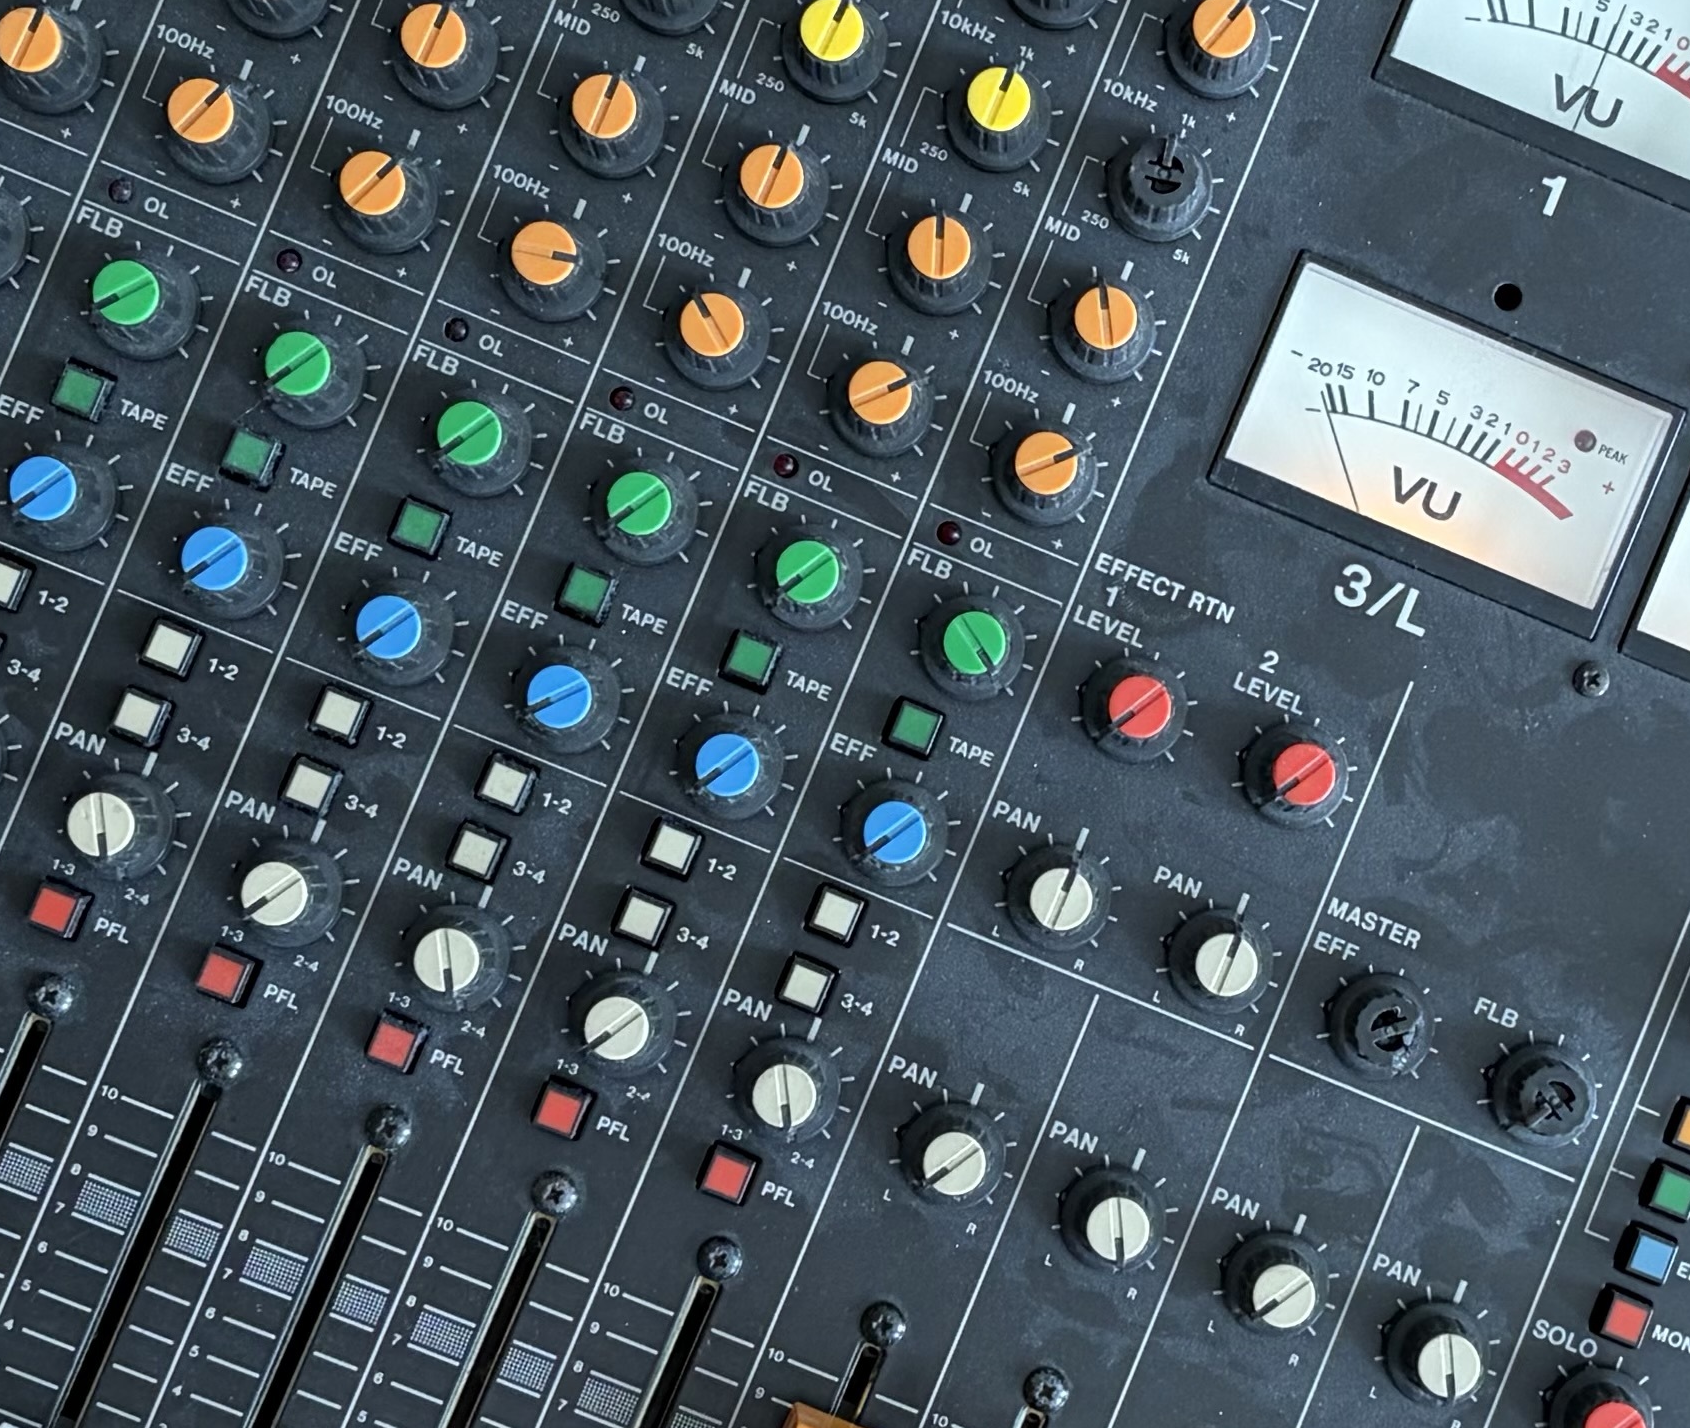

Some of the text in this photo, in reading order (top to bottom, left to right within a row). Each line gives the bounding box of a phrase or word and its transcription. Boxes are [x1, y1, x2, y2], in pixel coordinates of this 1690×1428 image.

[157, 23, 215, 60] 100Hz
[941, 9, 997, 45] 10kHz
[325, 94, 384, 130] 100Hz
[1103, 78, 1158, 113] 10kHz
[1554, 73, 1624, 129] VU
[881, 147, 919, 174] MID
[493, 163, 550, 199] 100Hz
[1541, 175, 1567, 217] 1
[76, 205, 124, 239] FLB
[143, 196, 169, 220] OL
[658, 232, 715, 268] 100Hz
[244, 274, 293, 308] FLB
[822, 300, 878, 336] 100Hz
[412, 343, 460, 376] FLB
[984, 369, 1039, 404] 100Hz
[579, 412, 626, 445] FLB
[643, 401, 669, 425] OL
[1597, 443, 1628, 466] PEAK
[165, 461, 215, 493] EFF
[1393, 465, 1463, 522] VU
[743, 479, 790, 512] FLB
[333, 531, 383, 561] EFF
[456, 535, 503, 568] TAPE
[906, 547, 953, 580] FLB
[1094, 551, 1236, 624] EFFECT RTN
[1105, 585, 1120, 608] 1
[1333, 563, 1426, 638] 3/L
[499, 599, 549, 630] EFF
[1072, 604, 1143, 649] LEVEL
[1258, 649, 1280, 675] 2
[665, 666, 714, 696] EFF
[1233, 671, 1304, 716] LEVEL
[54, 721, 107, 756] PAN
[176, 726, 211, 752] 3-4
[829, 732, 878, 762] EFF
[949, 735, 995, 768] TAPE
[224, 789, 277, 824] PAN
[543, 791, 573, 816] 1-2
[991, 799, 1042, 834] PAN
[391, 856, 444, 891] PAN
[1153, 865, 1203, 899] PAN
[557, 922, 609, 957] PAN
[676, 926, 710, 950] 3-4
[1327, 896, 1422, 950] MASTER
[1312, 930, 1361, 961] EFF
[293, 953, 319, 973] 2-4
[262, 983, 299, 1011] PFL
[722, 987, 773, 1022] PAN
[1473, 996, 1520, 1029] FLB
[887, 1054, 938, 1089] PAN
[1048, 1120, 1100, 1155] PAN
[760, 1180, 795, 1208] PFL
[1210, 1186, 1261, 1221] PAN
[1372, 1252, 1422, 1287] PAN
[1532, 1318, 1599, 1359] SOLO
